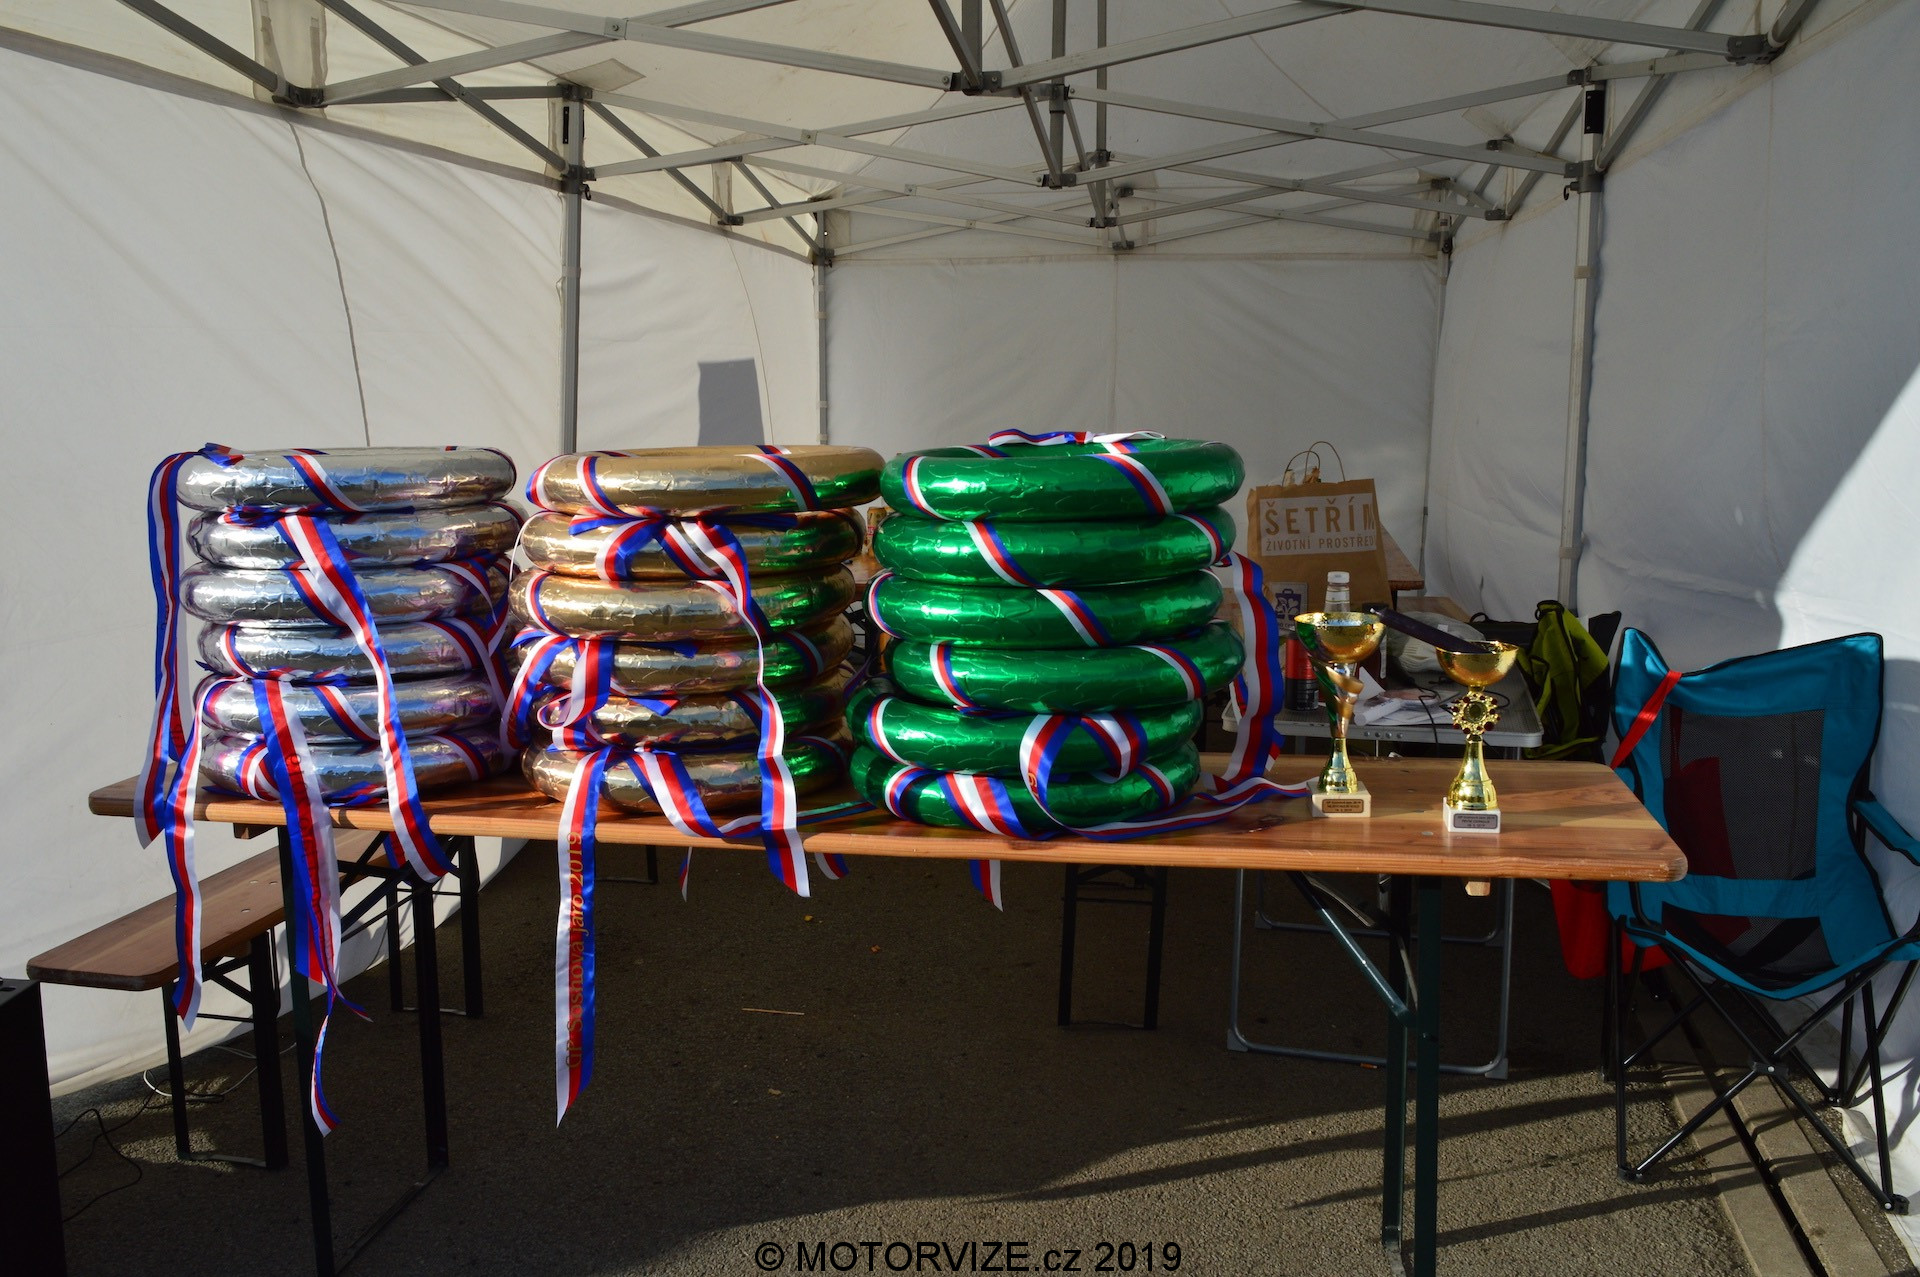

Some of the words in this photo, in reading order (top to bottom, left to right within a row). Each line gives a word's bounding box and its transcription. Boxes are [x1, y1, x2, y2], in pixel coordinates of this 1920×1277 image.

[1266, 536, 1311, 552] ŽIVOTNÍ
[1319, 533, 1376, 549] PROSTŘED
[567, 830, 585, 888] 2019
[567, 893, 590, 937] jaro
[565, 1039, 582, 1068] GP
